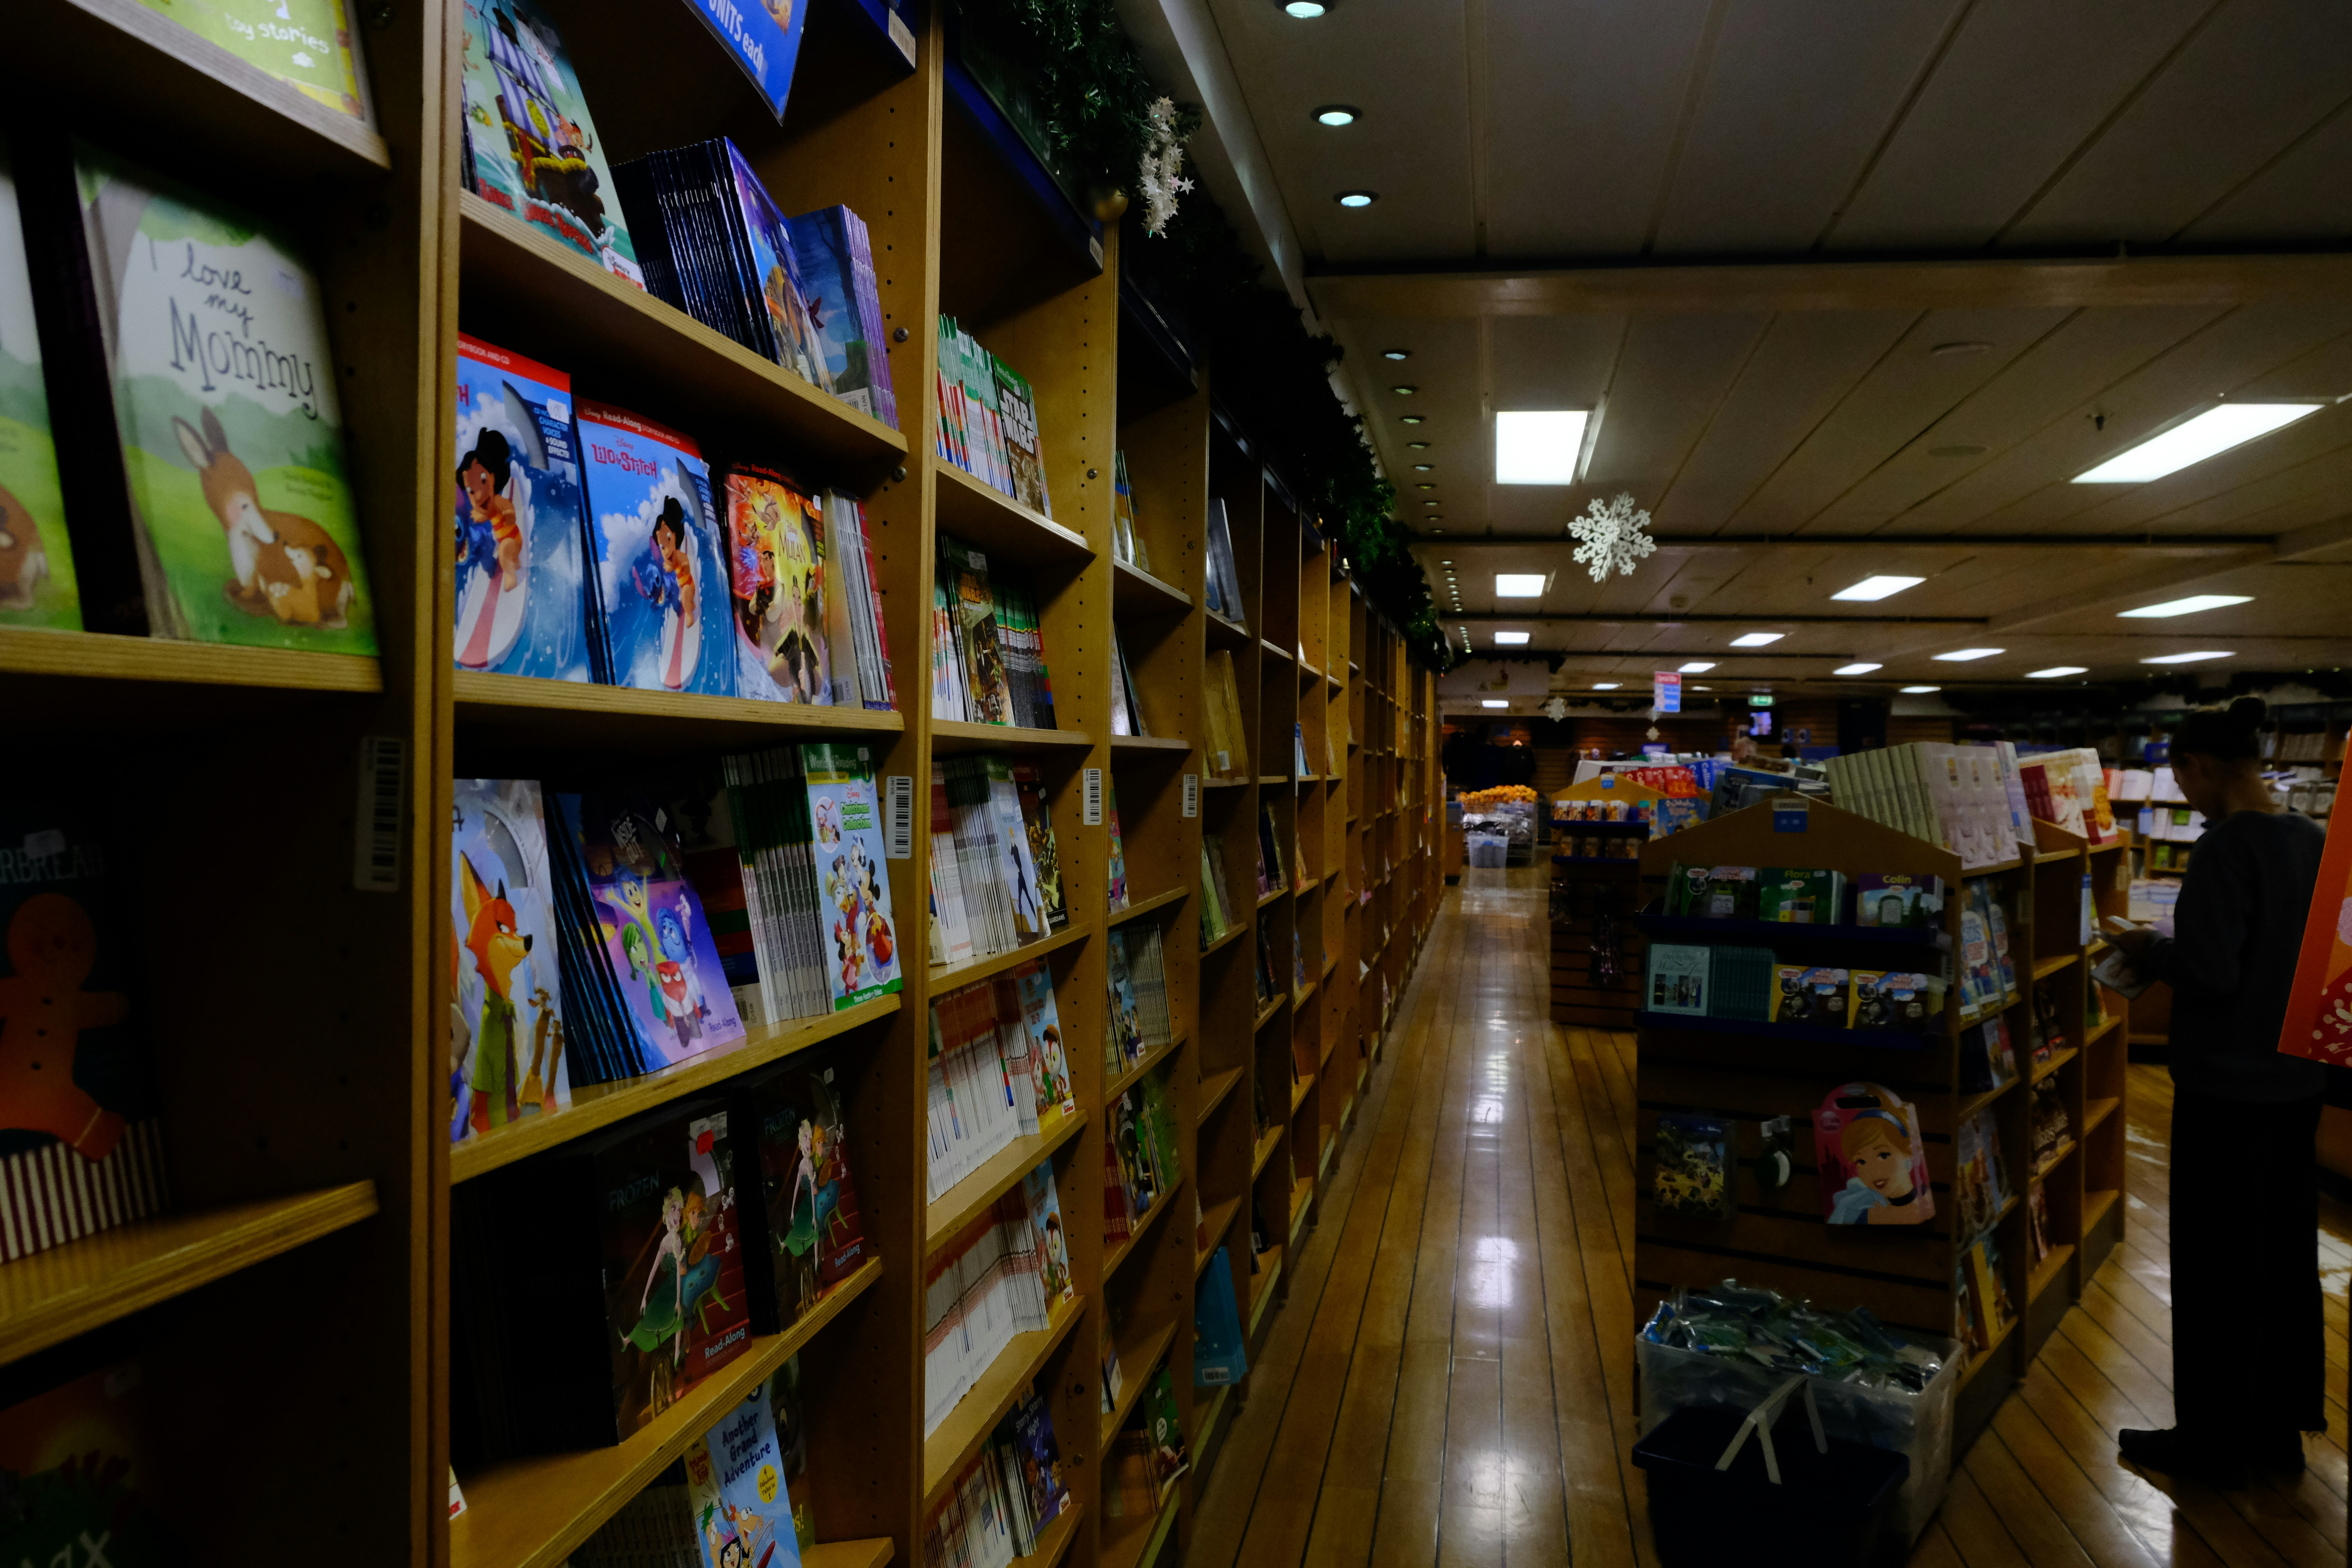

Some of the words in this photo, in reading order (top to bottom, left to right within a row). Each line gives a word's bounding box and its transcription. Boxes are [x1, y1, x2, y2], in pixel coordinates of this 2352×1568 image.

[258, 21, 330, 54] stories
[743, 32, 763, 72] each
[181, 241, 252, 295] love
[205, 295, 254, 338] my
[170, 295, 318, 420] Mommy
[501, 355, 510, 364] CD
[603, 410, 642, 432] Read-Along
[1000, 388, 1033, 432] STAR
[539, 416, 568, 432] CHARACTER
[543, 426, 562, 438] VOICES
[1003, 410, 1034, 454] WARS
[549, 437, 568, 450] SOUND
[960, 585, 981, 604] WARS
[841, 800, 870, 816] Christmas
[842, 815, 872, 831] Collection
[1784, 870, 1811, 879] Flora
[1882, 874, 1912, 884] Colin
[1049, 914, 1065, 924] GUARDIANS
[708, 1018, 737, 1032] Read-Along
[609, 1170, 660, 1212] FROZEN
[835, 1244, 860, 1268] Read-Along
[705, 1327, 746, 1359] Read-Along
[1029, 1395, 1043, 1415] Starry
[722, 1412, 758, 1447] Another
[1027, 1416, 1040, 1438] Night
[730, 1427, 758, 1462] Grand
[724, 1443, 770, 1488] Adventure
[762, 1486, 771, 1496] Tales
